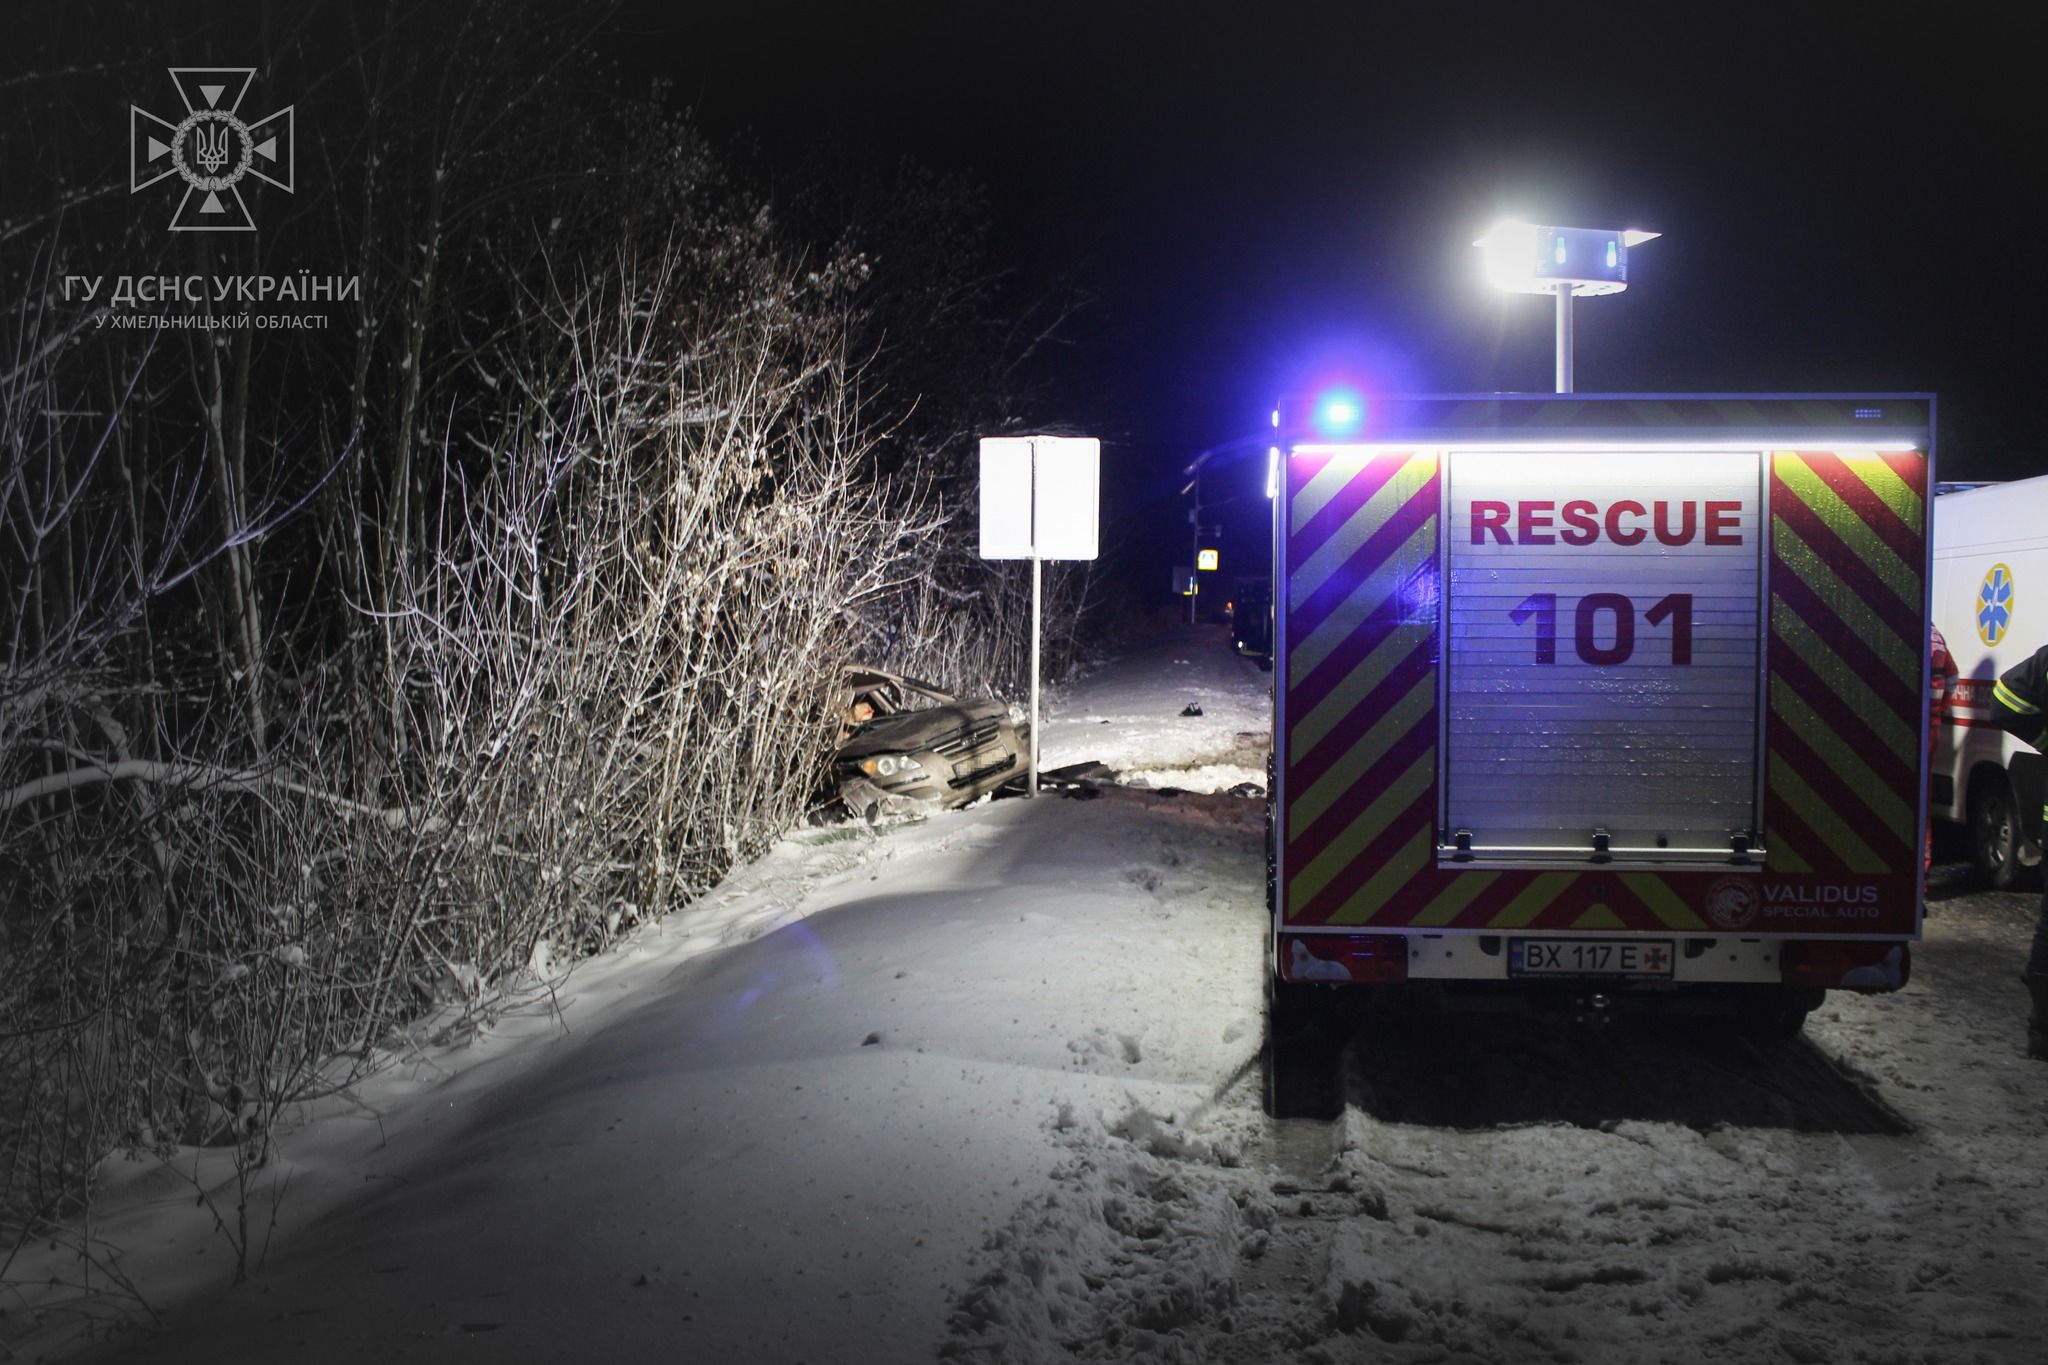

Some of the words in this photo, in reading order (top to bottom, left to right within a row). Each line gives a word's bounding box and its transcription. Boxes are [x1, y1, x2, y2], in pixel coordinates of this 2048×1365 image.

[1471, 500, 1743, 546] RESCUE
[1508, 593, 1692, 665] 101
[1763, 885, 1878, 903] VALIDUS
[1763, 906, 1828, 918] SPECIAL
[1835, 906, 1879, 918] AUTO
[1527, 945, 1561, 968] BX
[1573, 946, 1612, 969] 117
[1620, 946, 1637, 969] E
